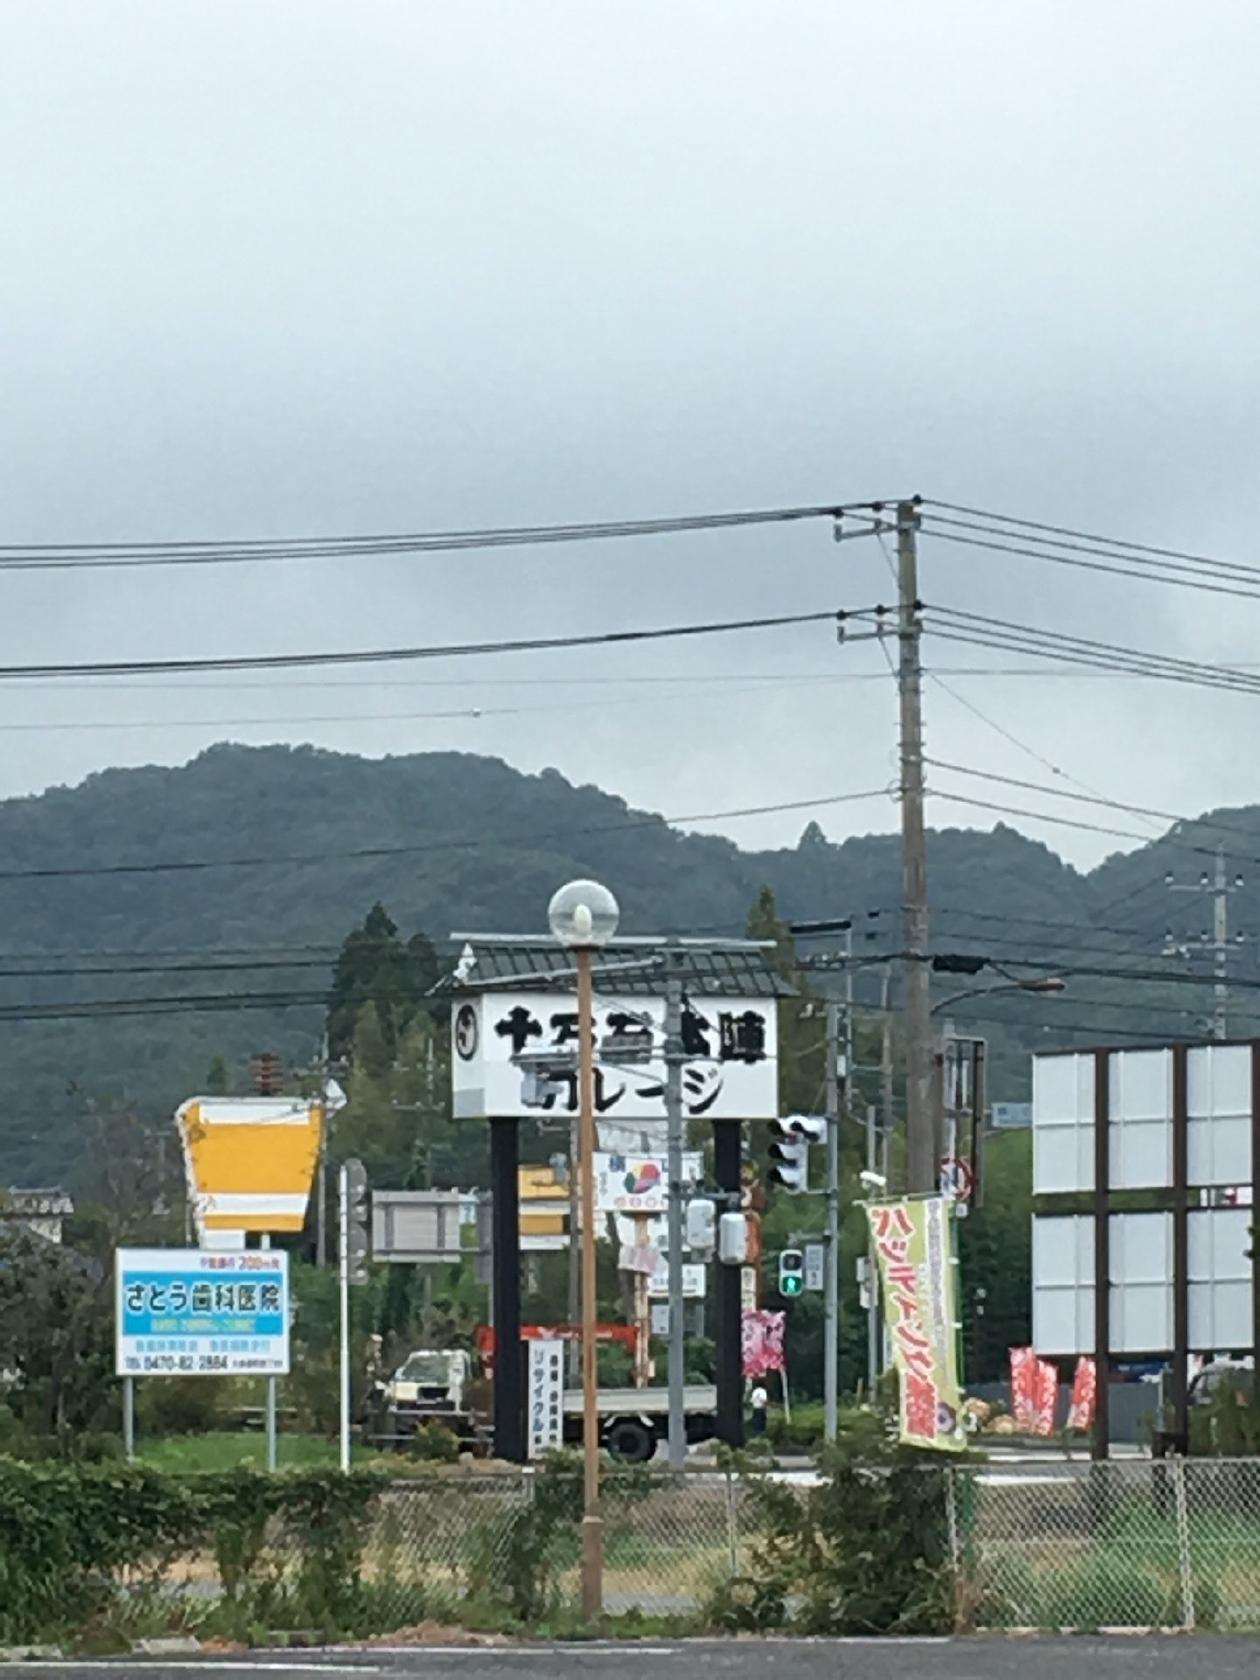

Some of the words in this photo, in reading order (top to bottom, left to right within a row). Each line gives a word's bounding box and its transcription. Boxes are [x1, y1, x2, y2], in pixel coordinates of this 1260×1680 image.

[127, 1283, 280, 1312] さとう歯科医院
